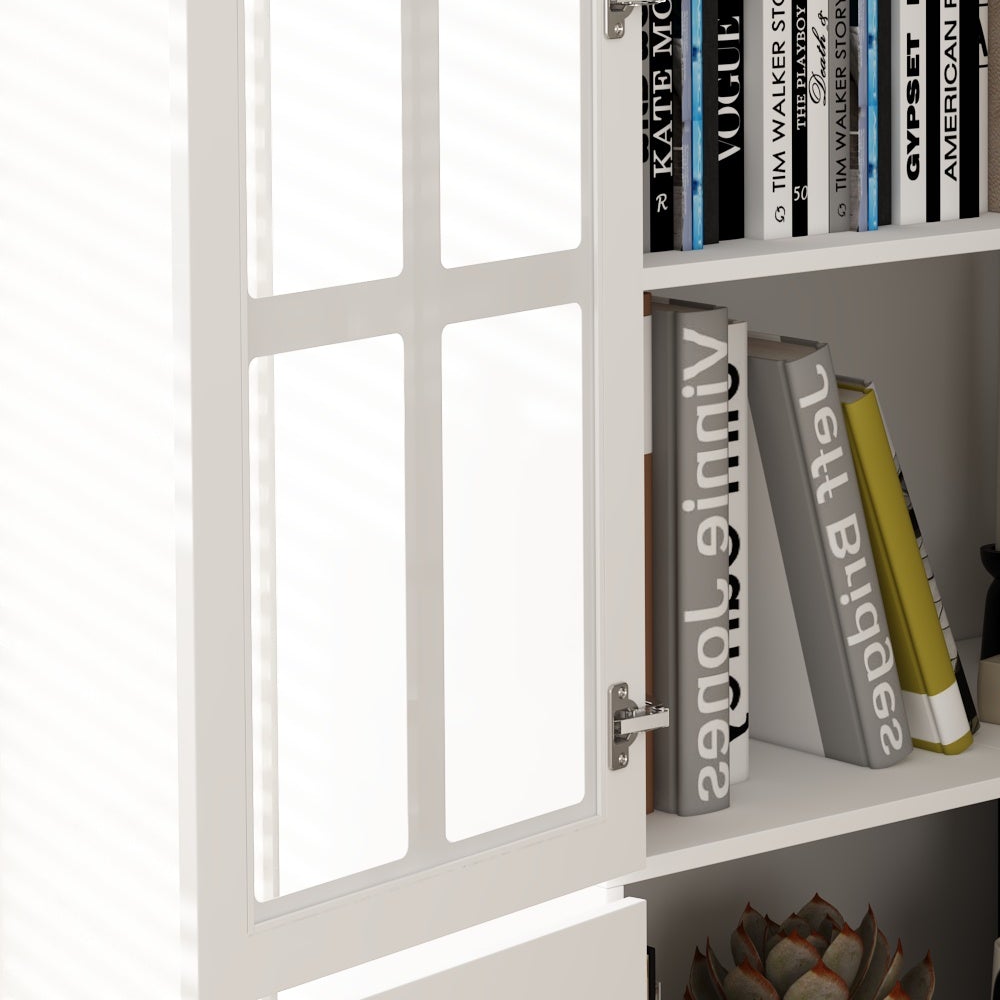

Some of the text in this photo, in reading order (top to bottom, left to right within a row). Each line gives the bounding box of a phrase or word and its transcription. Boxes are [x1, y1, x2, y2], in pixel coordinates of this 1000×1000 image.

[796, 6, 806, 88] PLAYBOY
[652, 68, 673, 179] KATE
[717, 16, 741, 162] VOGUE
[771, 40, 786, 142] WALKER
[796, 93, 806, 131] THE
[835, 67, 847, 150] WALKER
[906, 33, 920, 181] GYPSET
[944, 20, 957, 182] AMERICAN
[771, 151, 786, 193] TIM
[793, 185, 808, 201] 50
[835, 158, 847, 192] TIM
